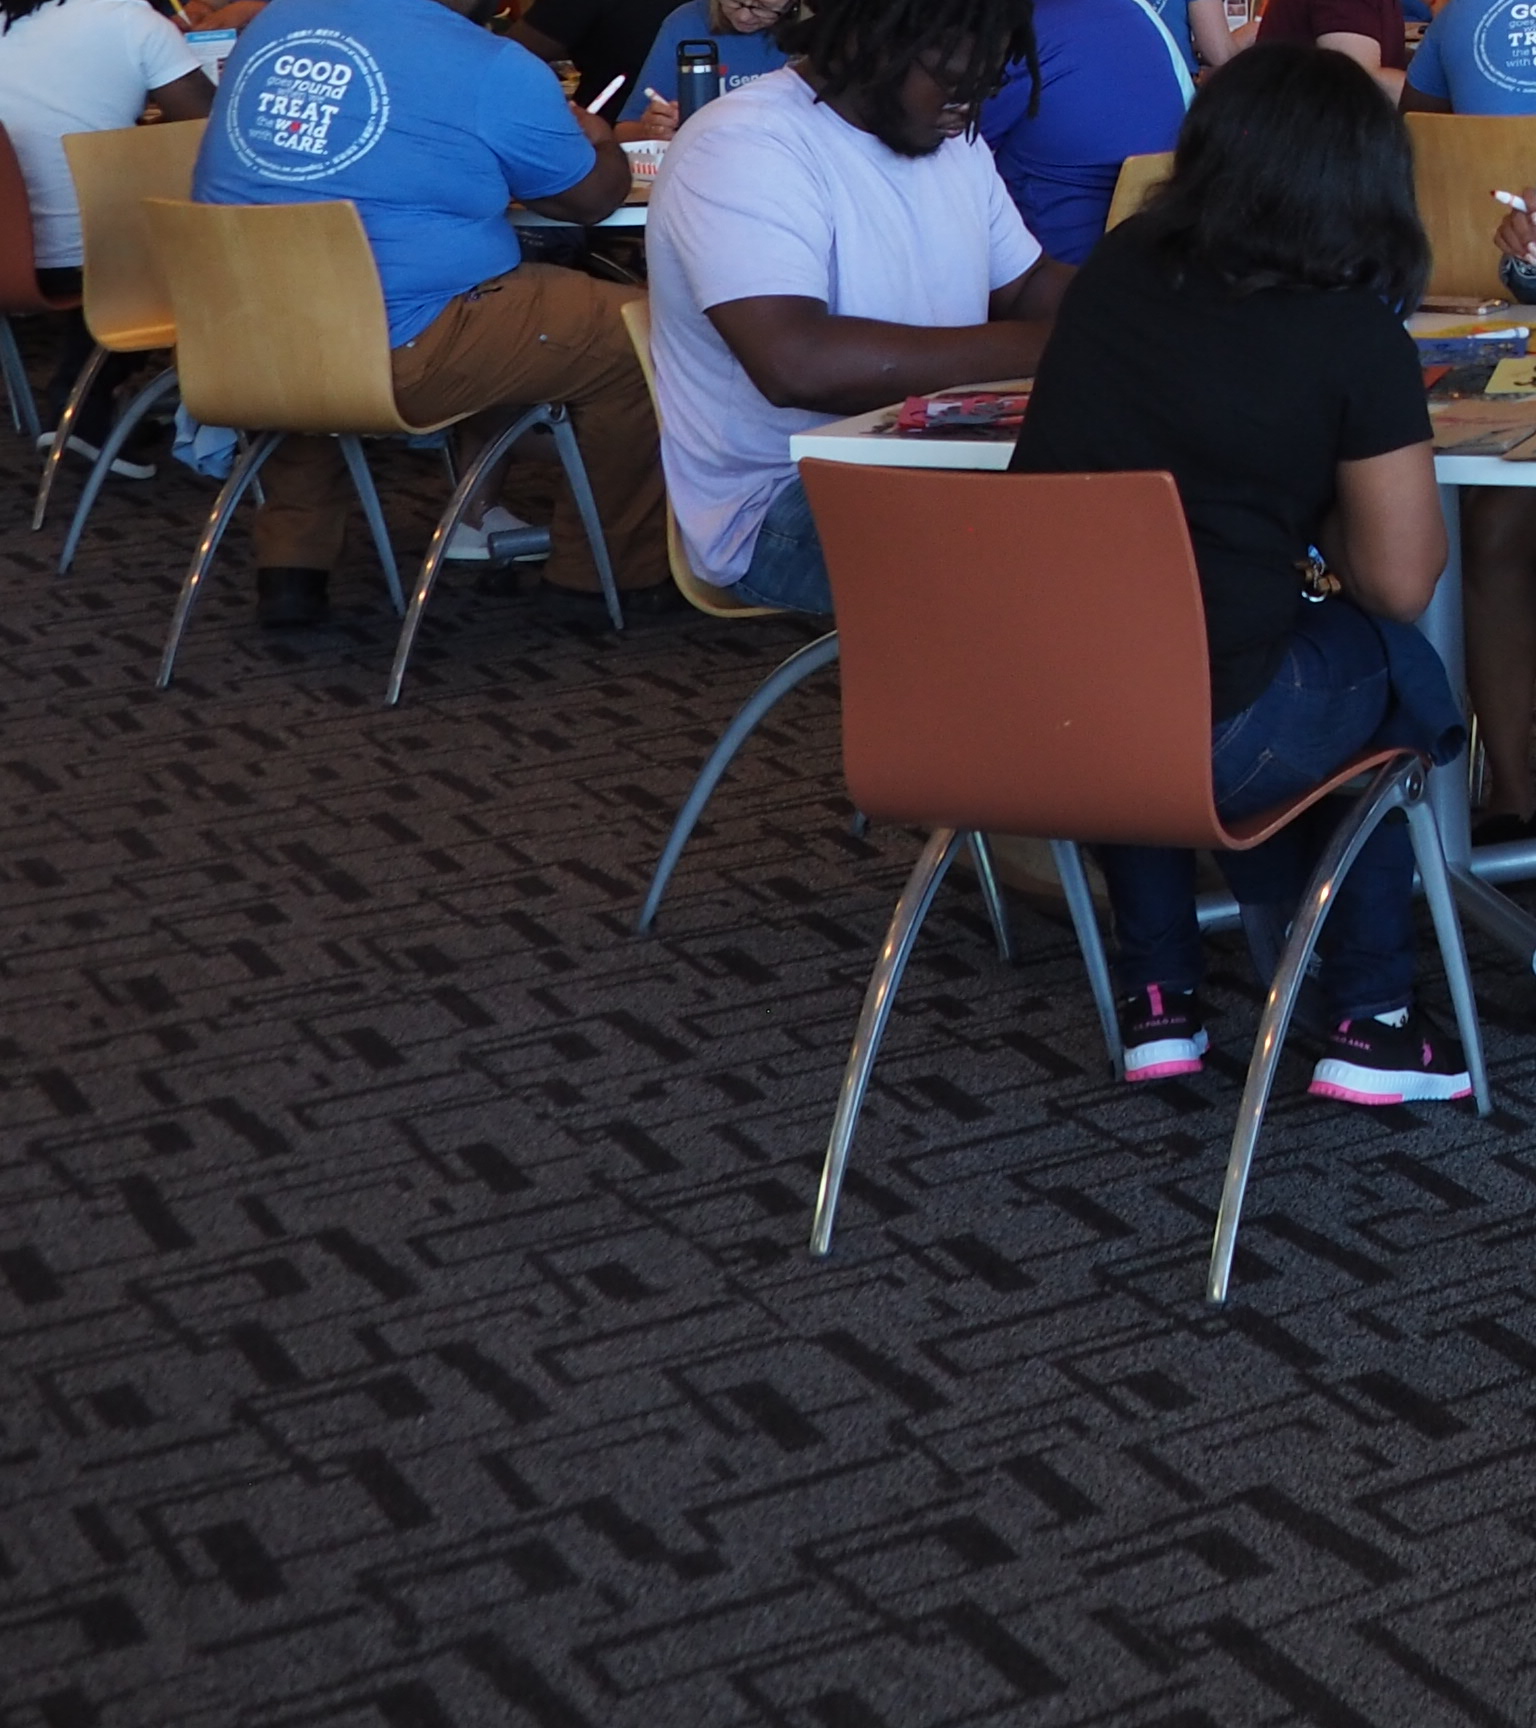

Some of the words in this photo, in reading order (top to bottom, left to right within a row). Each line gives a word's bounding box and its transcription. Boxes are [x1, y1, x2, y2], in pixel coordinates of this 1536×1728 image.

[274, 55, 352, 85] GOOD
[291, 79, 347, 100] round
[258, 92, 339, 124] TREAT
[273, 131, 328, 155] CARE.
